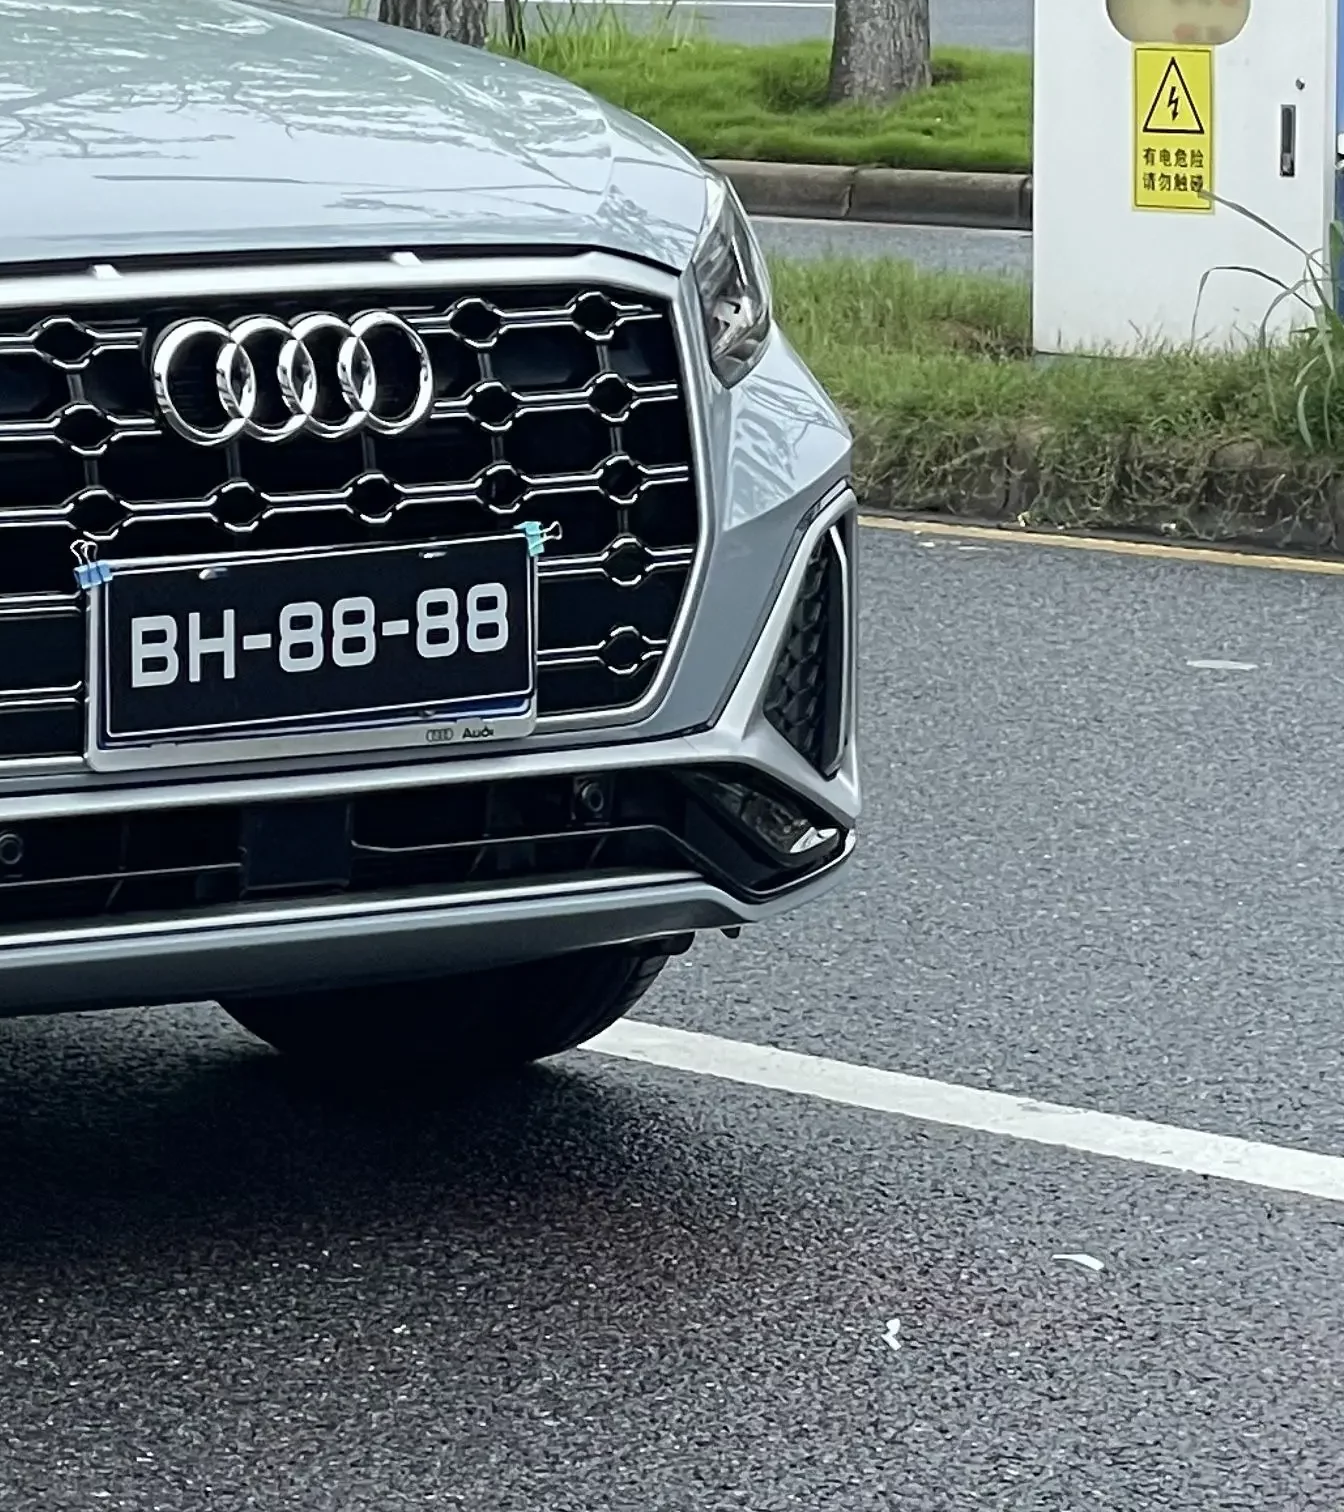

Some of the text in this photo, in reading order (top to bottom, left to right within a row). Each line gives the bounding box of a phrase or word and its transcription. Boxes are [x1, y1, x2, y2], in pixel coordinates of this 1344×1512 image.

[1143, 147, 1204, 168] 有电危险
[131, 582, 509, 688] BH-88-88
[462, 724, 495, 739] Audi
